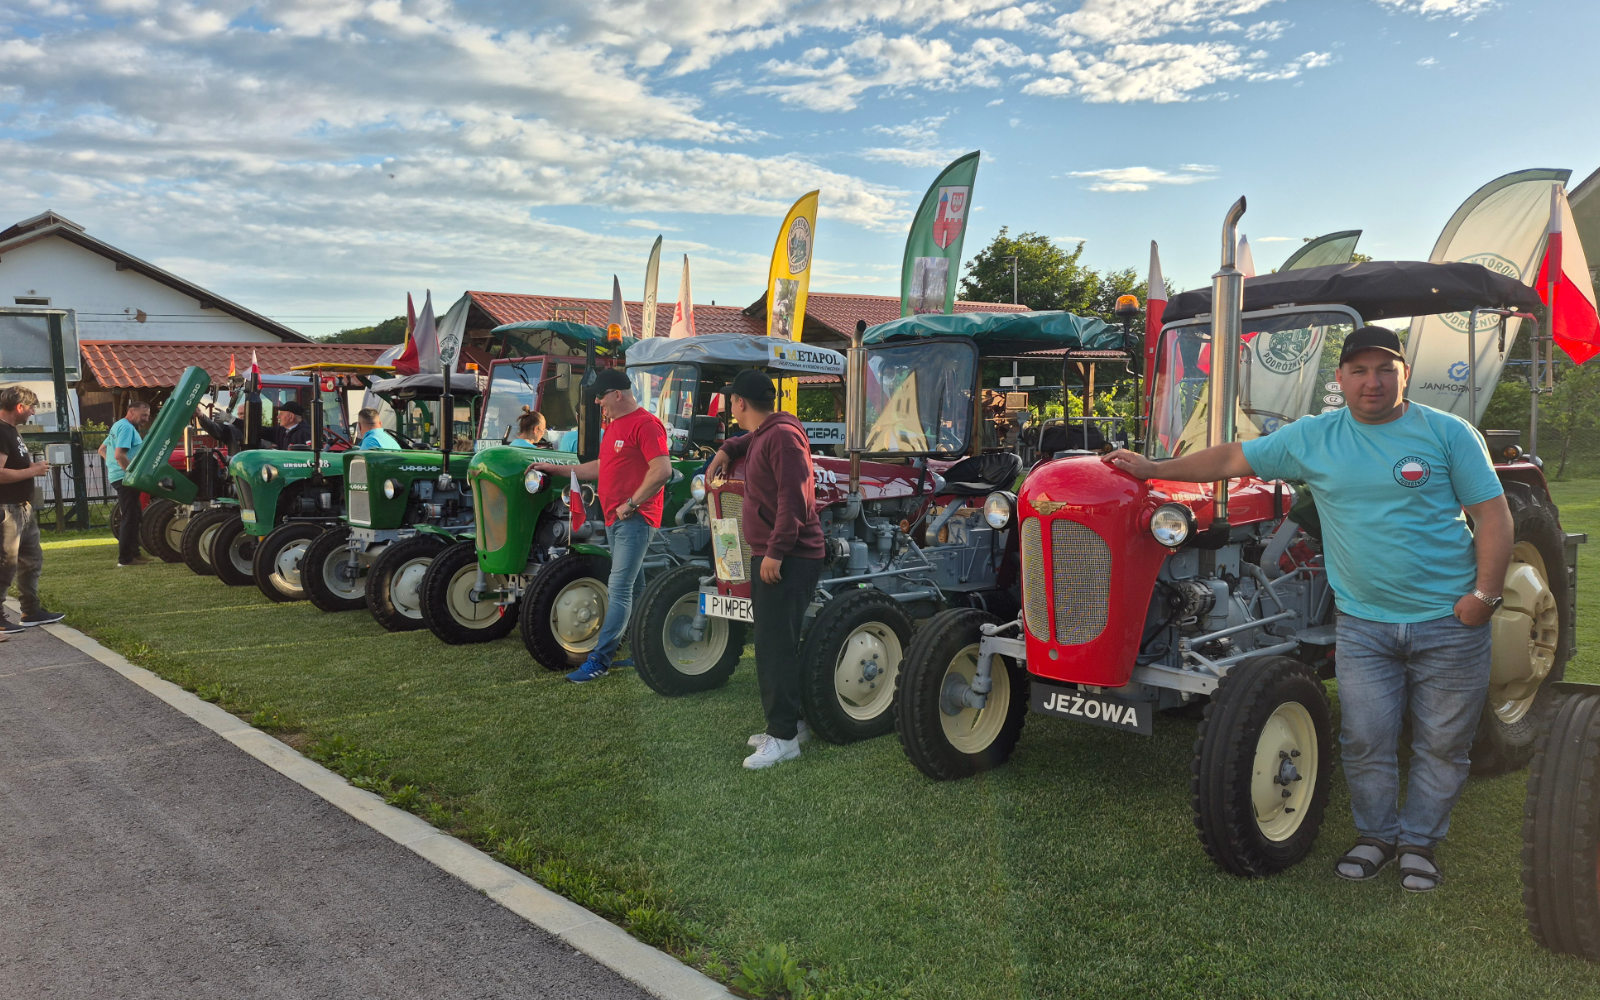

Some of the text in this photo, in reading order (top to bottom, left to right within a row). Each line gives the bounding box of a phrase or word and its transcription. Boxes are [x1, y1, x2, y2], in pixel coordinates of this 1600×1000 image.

[786, 349, 840, 366] METAPOL
[152, 438, 171, 470] URSUS
[307, 459, 330, 469] C-28
[712, 597, 753, 619] PIMPEK
[1043, 692, 1138, 727] JEŻOWA
